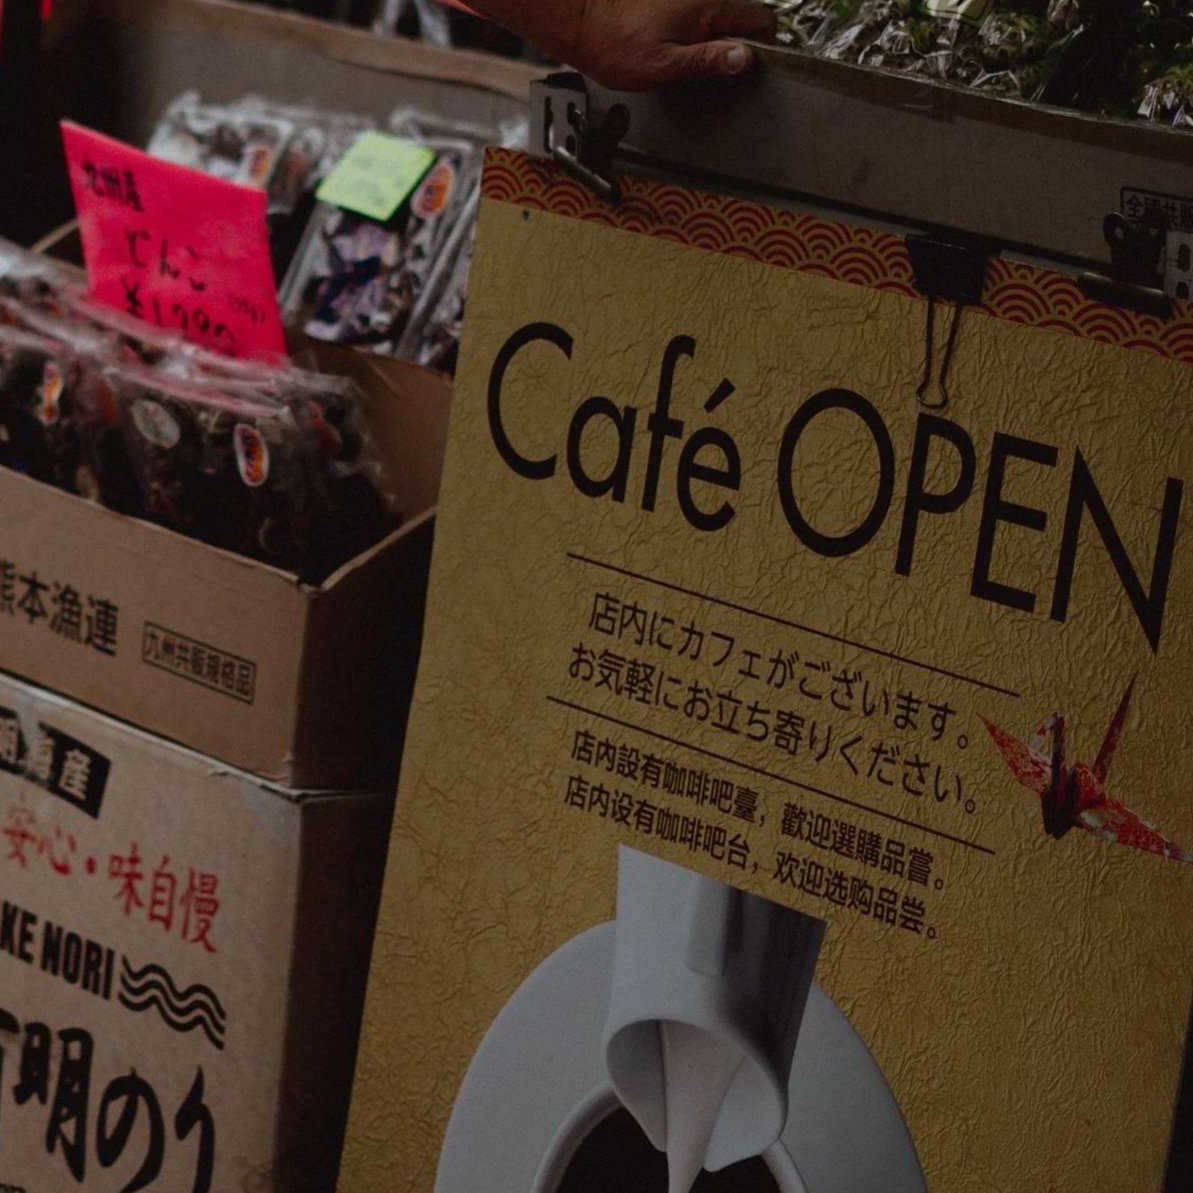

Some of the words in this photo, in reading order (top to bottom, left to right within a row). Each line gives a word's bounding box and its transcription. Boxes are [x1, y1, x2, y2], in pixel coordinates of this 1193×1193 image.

[487, 321, 741, 532] Café
[777, 387, 1184, 656] OPEN
[568, 642, 976, 815] お気軽にお立ち寄りください。
[588, 592, 969, 750] 店内にカフェがございます。
[40, 920, 115, 1000] NORI
